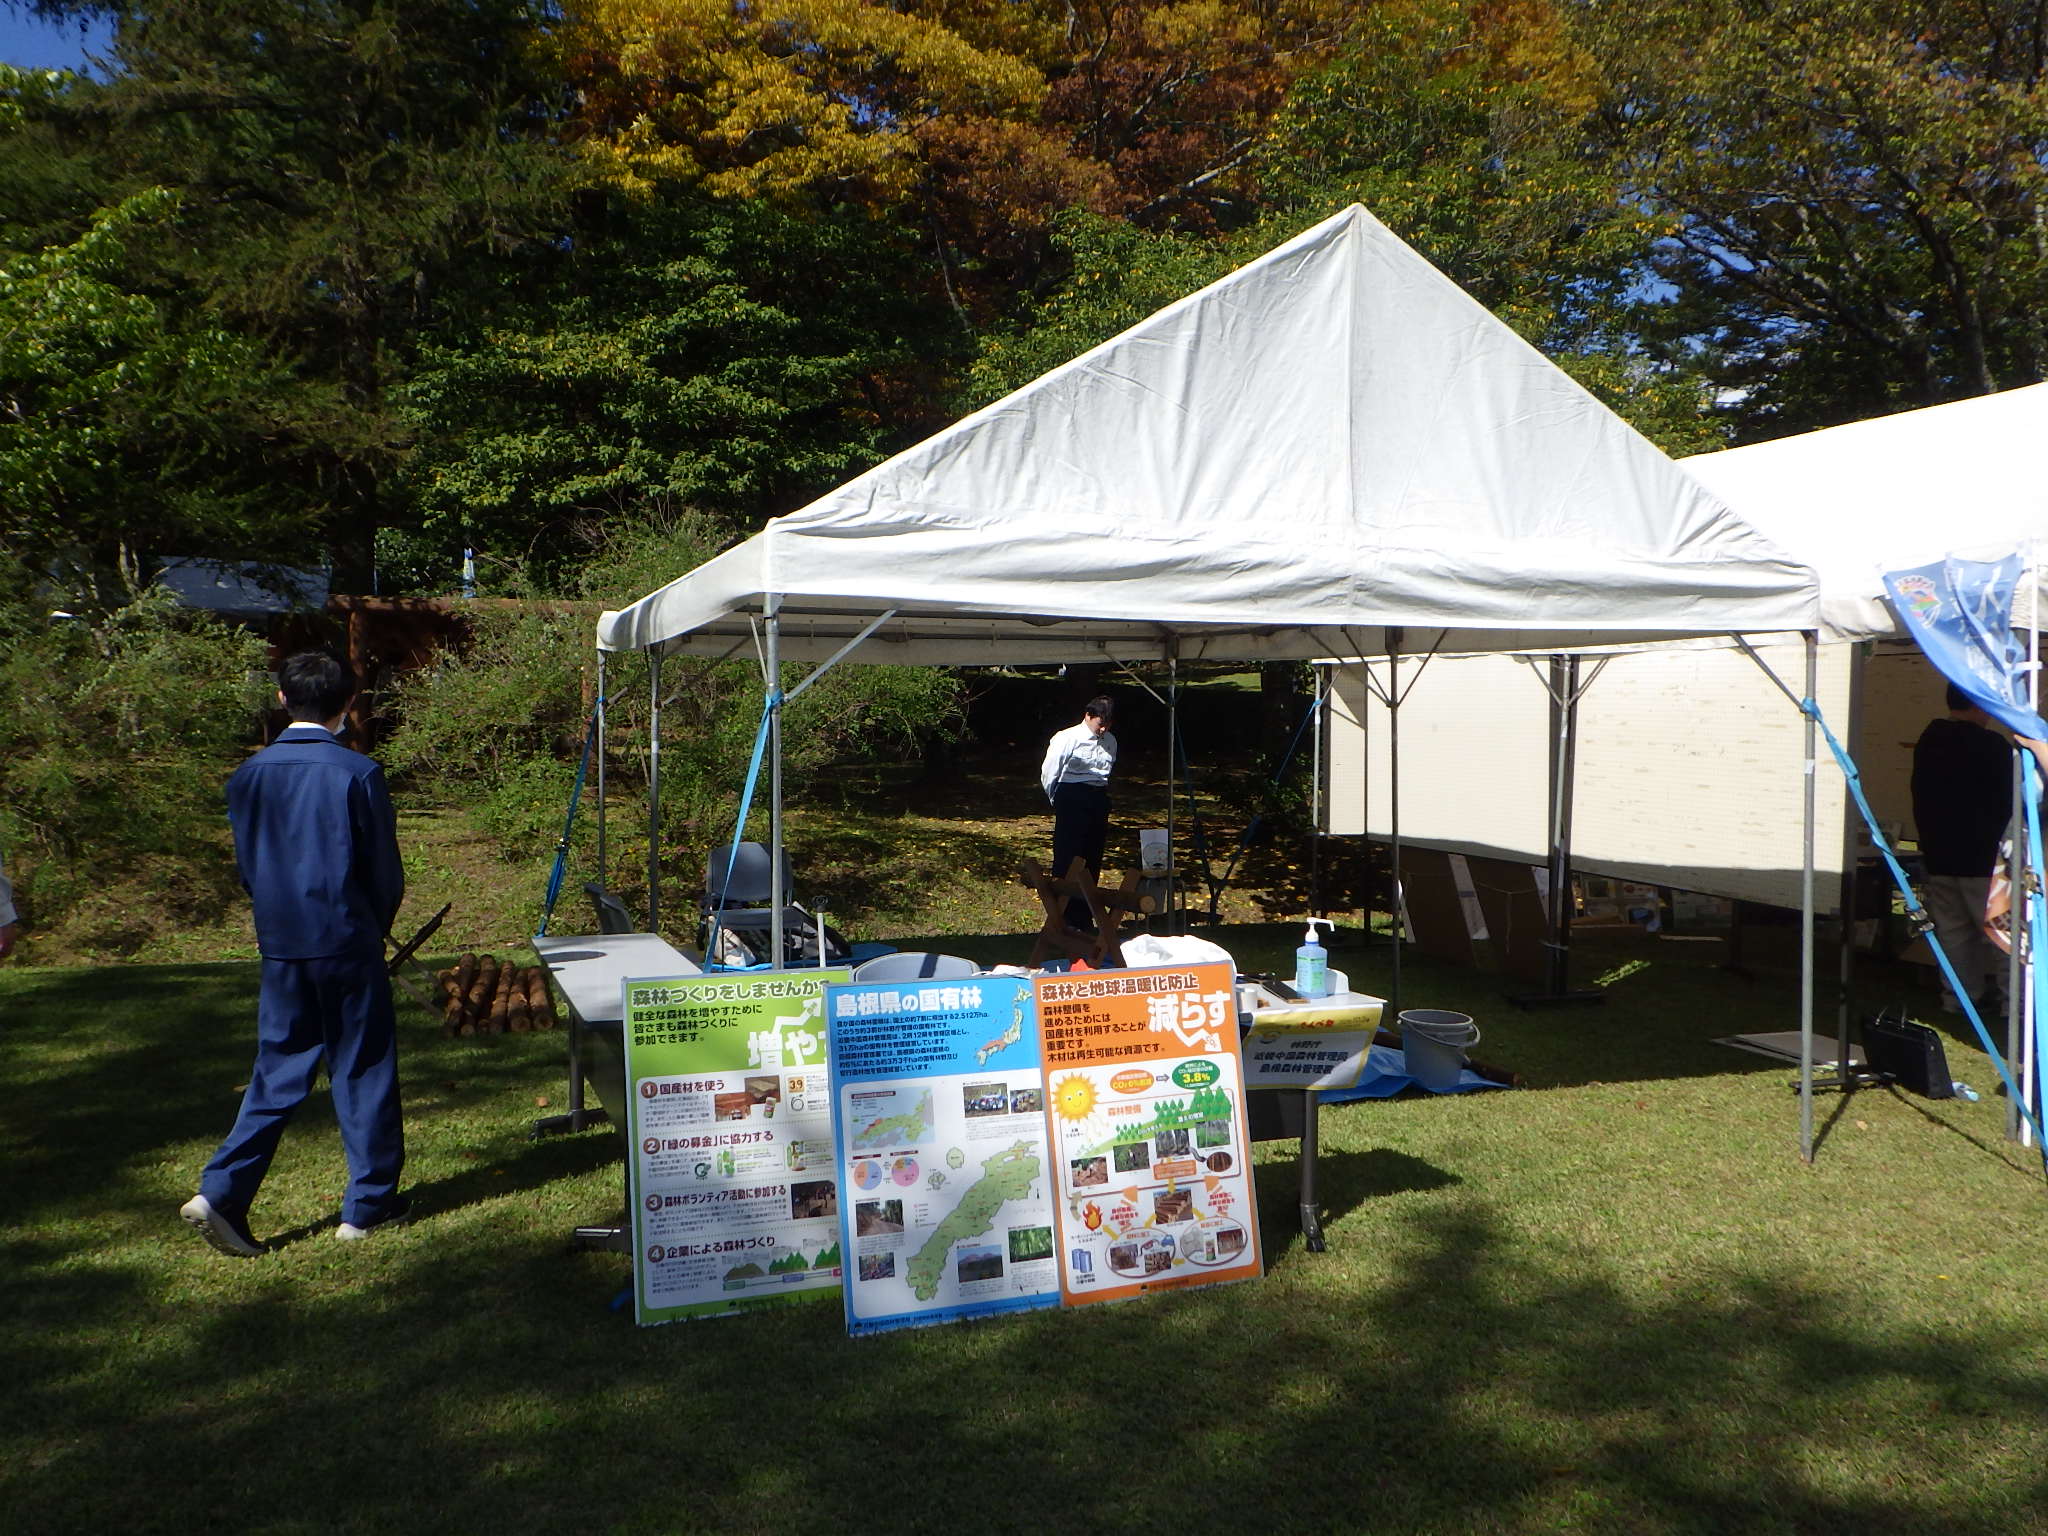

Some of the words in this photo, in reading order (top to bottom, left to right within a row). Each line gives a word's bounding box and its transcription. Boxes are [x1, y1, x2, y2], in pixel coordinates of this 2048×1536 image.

[1041, 973, 1199, 1002] 森林と地球温暖化防止
[836, 986, 982, 1017] 島根県の国有林
[1044, 1004, 1090, 1016] 森林整備を
[633, 1004, 763, 1022] 健全な森林を増やすために
[1147, 990, 1230, 1032] 減らす
[633, 1018, 738, 1034] 皆さまも森林づくりに
[1044, 1013, 1111, 1028] 進めるためには
[634, 1032, 704, 1046] 参加できます。
[1045, 1021, 1146, 1040] 国産材を利用することが
[1046, 1039, 1090, 1051] 重要です。
[1047, 1043, 1166, 1063] 木材は再生可能な資源です。
[659, 1079, 725, 1096] 国産材を使う
[1182, 1073, 1211, 1084] 3.8%
[660, 1131, 774, 1150] 「緑の募金」に協力する
[664, 1185, 787, 1208] 森林ボランティア活動に参加する
[666, 1236, 775, 1259] 企業による森林づくり
